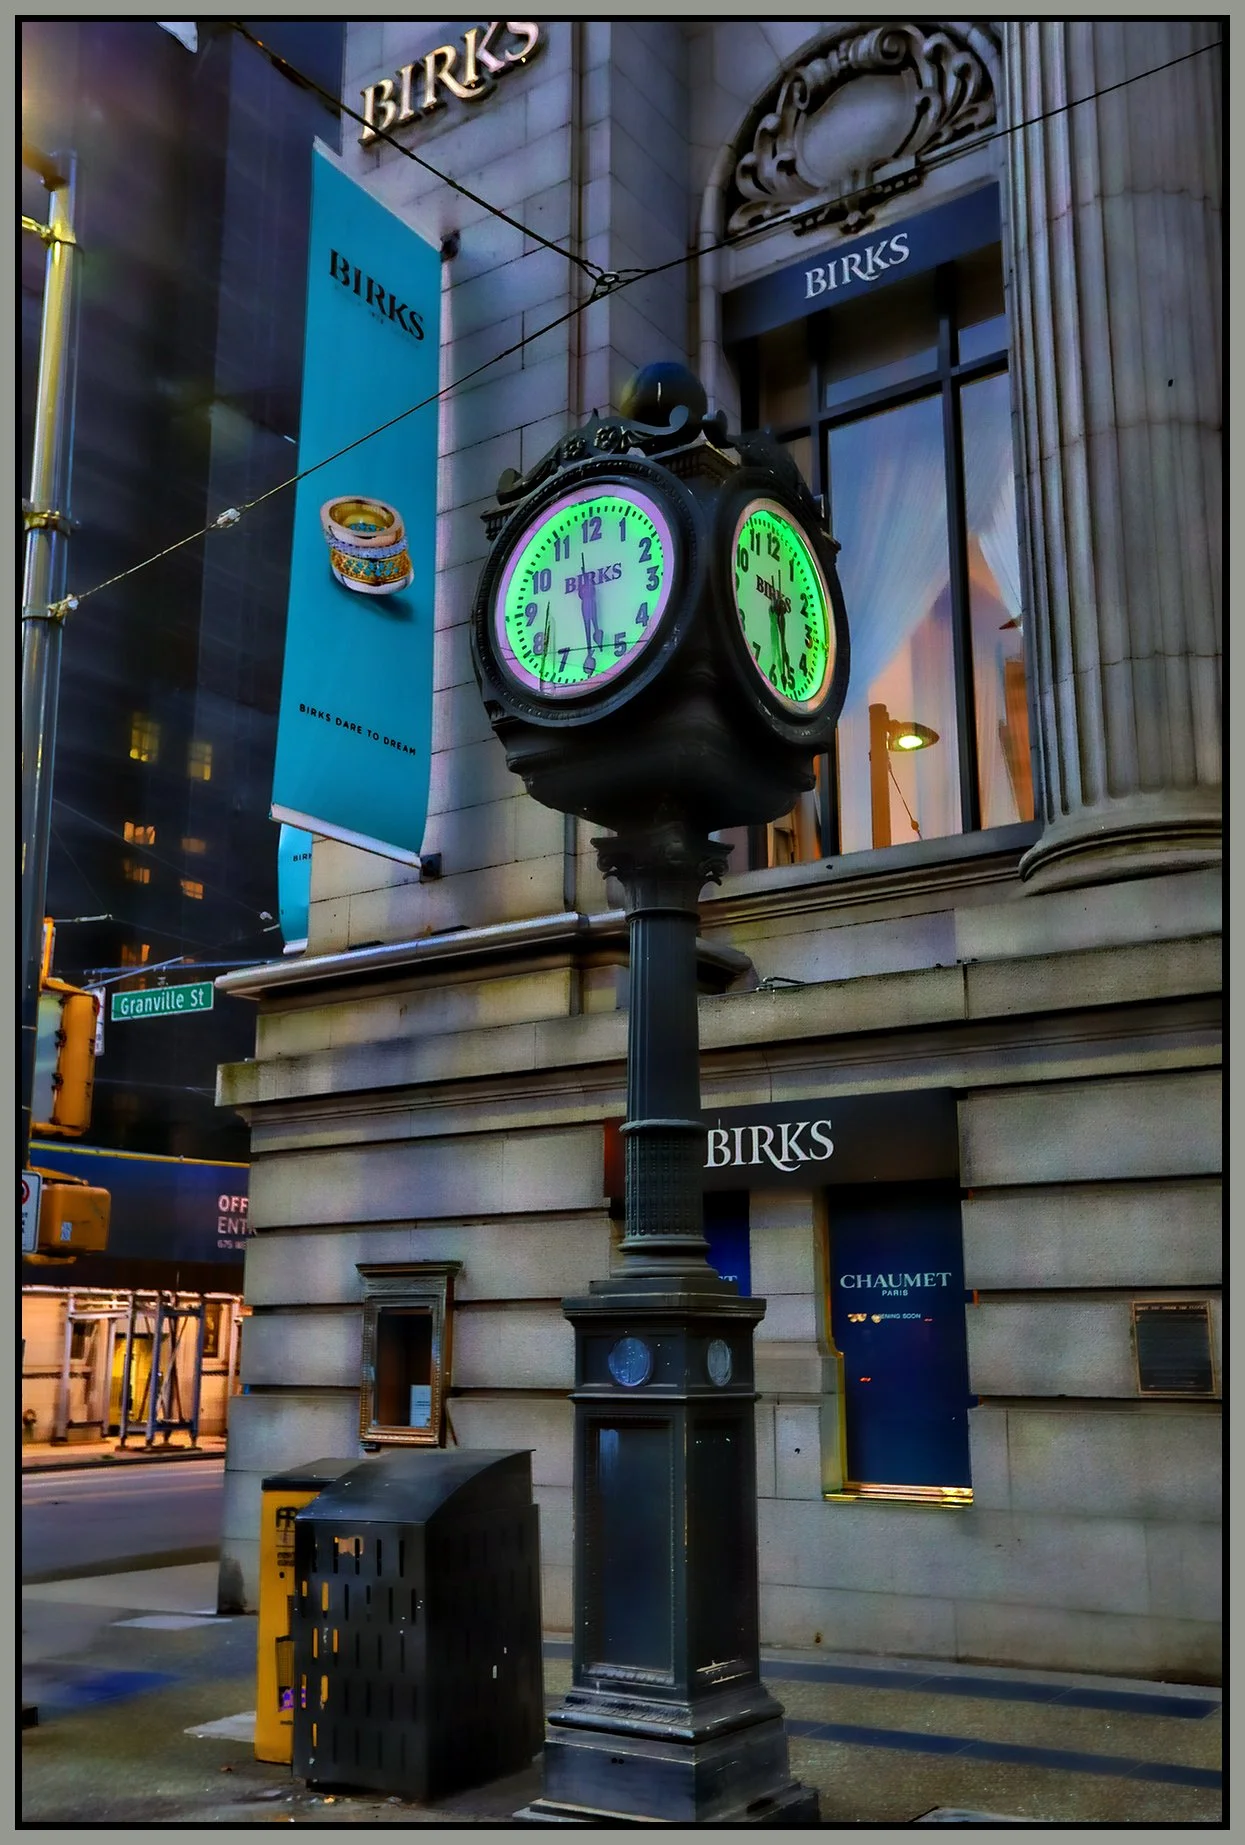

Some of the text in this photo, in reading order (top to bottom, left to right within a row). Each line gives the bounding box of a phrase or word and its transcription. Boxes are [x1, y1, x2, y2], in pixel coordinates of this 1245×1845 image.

[361, 21, 540, 140] BIRKS
[804, 233, 910, 299] BIRKS
[330, 248, 424, 341] BIRKS
[581, 516, 602, 543] 12
[619, 517, 626, 542] 1
[750, 527, 761, 556] 11
[554, 535, 570, 562] 11
[638, 537, 652, 563] 2
[736, 544, 749, 573] 10
[767, 532, 780, 562] 12
[533, 568, 552, 595] 10
[564, 562, 622, 595] BIRKS
[646, 565, 660, 592] 3
[789, 557, 795, 582] 1
[525, 602, 538, 627] 9
[635, 602, 649, 627] 4
[800, 592, 809, 619] 2
[533, 632, 545, 656] 8
[614, 632, 627, 657] 5
[804, 624, 814, 649] 3
[558, 647, 571, 673] 7
[799, 653, 808, 678] 4
[769, 663, 778, 687] 6
[300, 703, 416, 756] BIRKS DARE TO DREAM
[120, 988, 205, 1015] Granville St
[703, 1119, 834, 1172] BIRKS
[218, 1194, 249, 1213] OFF
[840, 1272, 952, 1289] CHAUMET
[881, 1289, 909, 1297] PARIS
